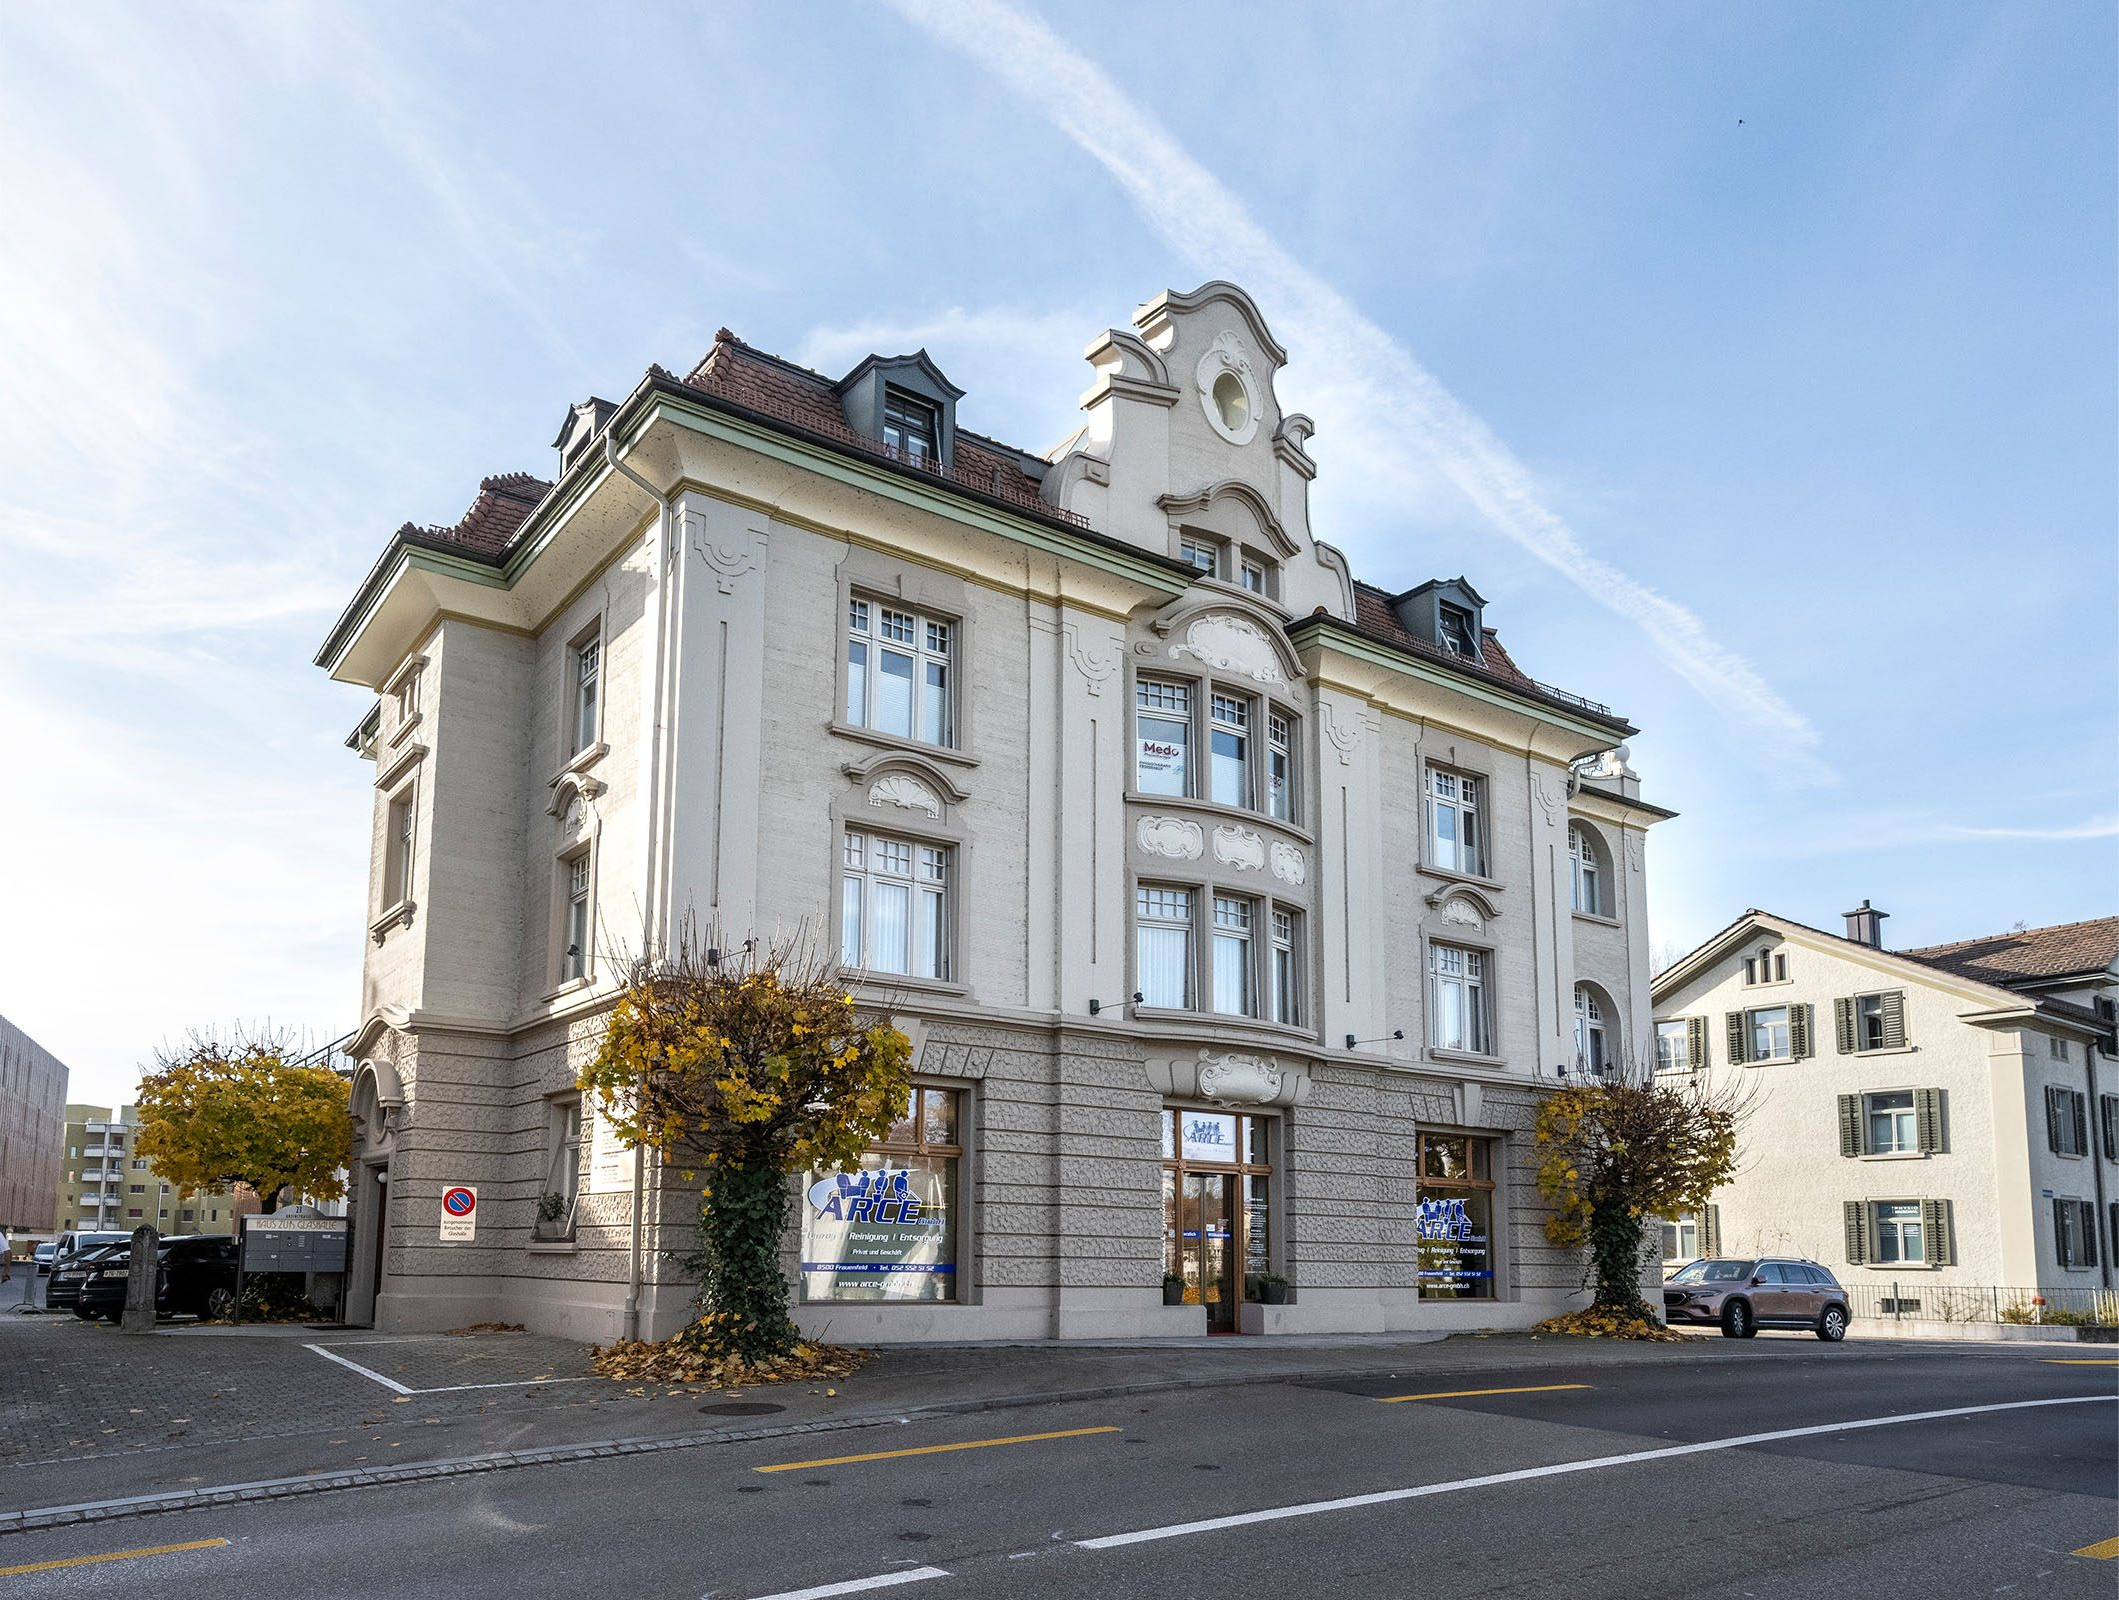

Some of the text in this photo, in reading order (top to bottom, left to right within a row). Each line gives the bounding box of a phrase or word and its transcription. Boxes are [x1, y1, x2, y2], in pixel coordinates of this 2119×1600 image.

[1189, 1132, 1225, 1145] ARCE
[815, 1196, 922, 1225] ARCE
[256, 1220, 277, 1229] HAUS
[297, 1220, 336, 1230] GLASHALLE
[1416, 1219, 1473, 1241] ARCE
[849, 1232, 889, 1243] Reinigung
[899, 1233, 944, 1244] Entsorgung
[1459, 1247, 1486, 1256] Entsorgung
